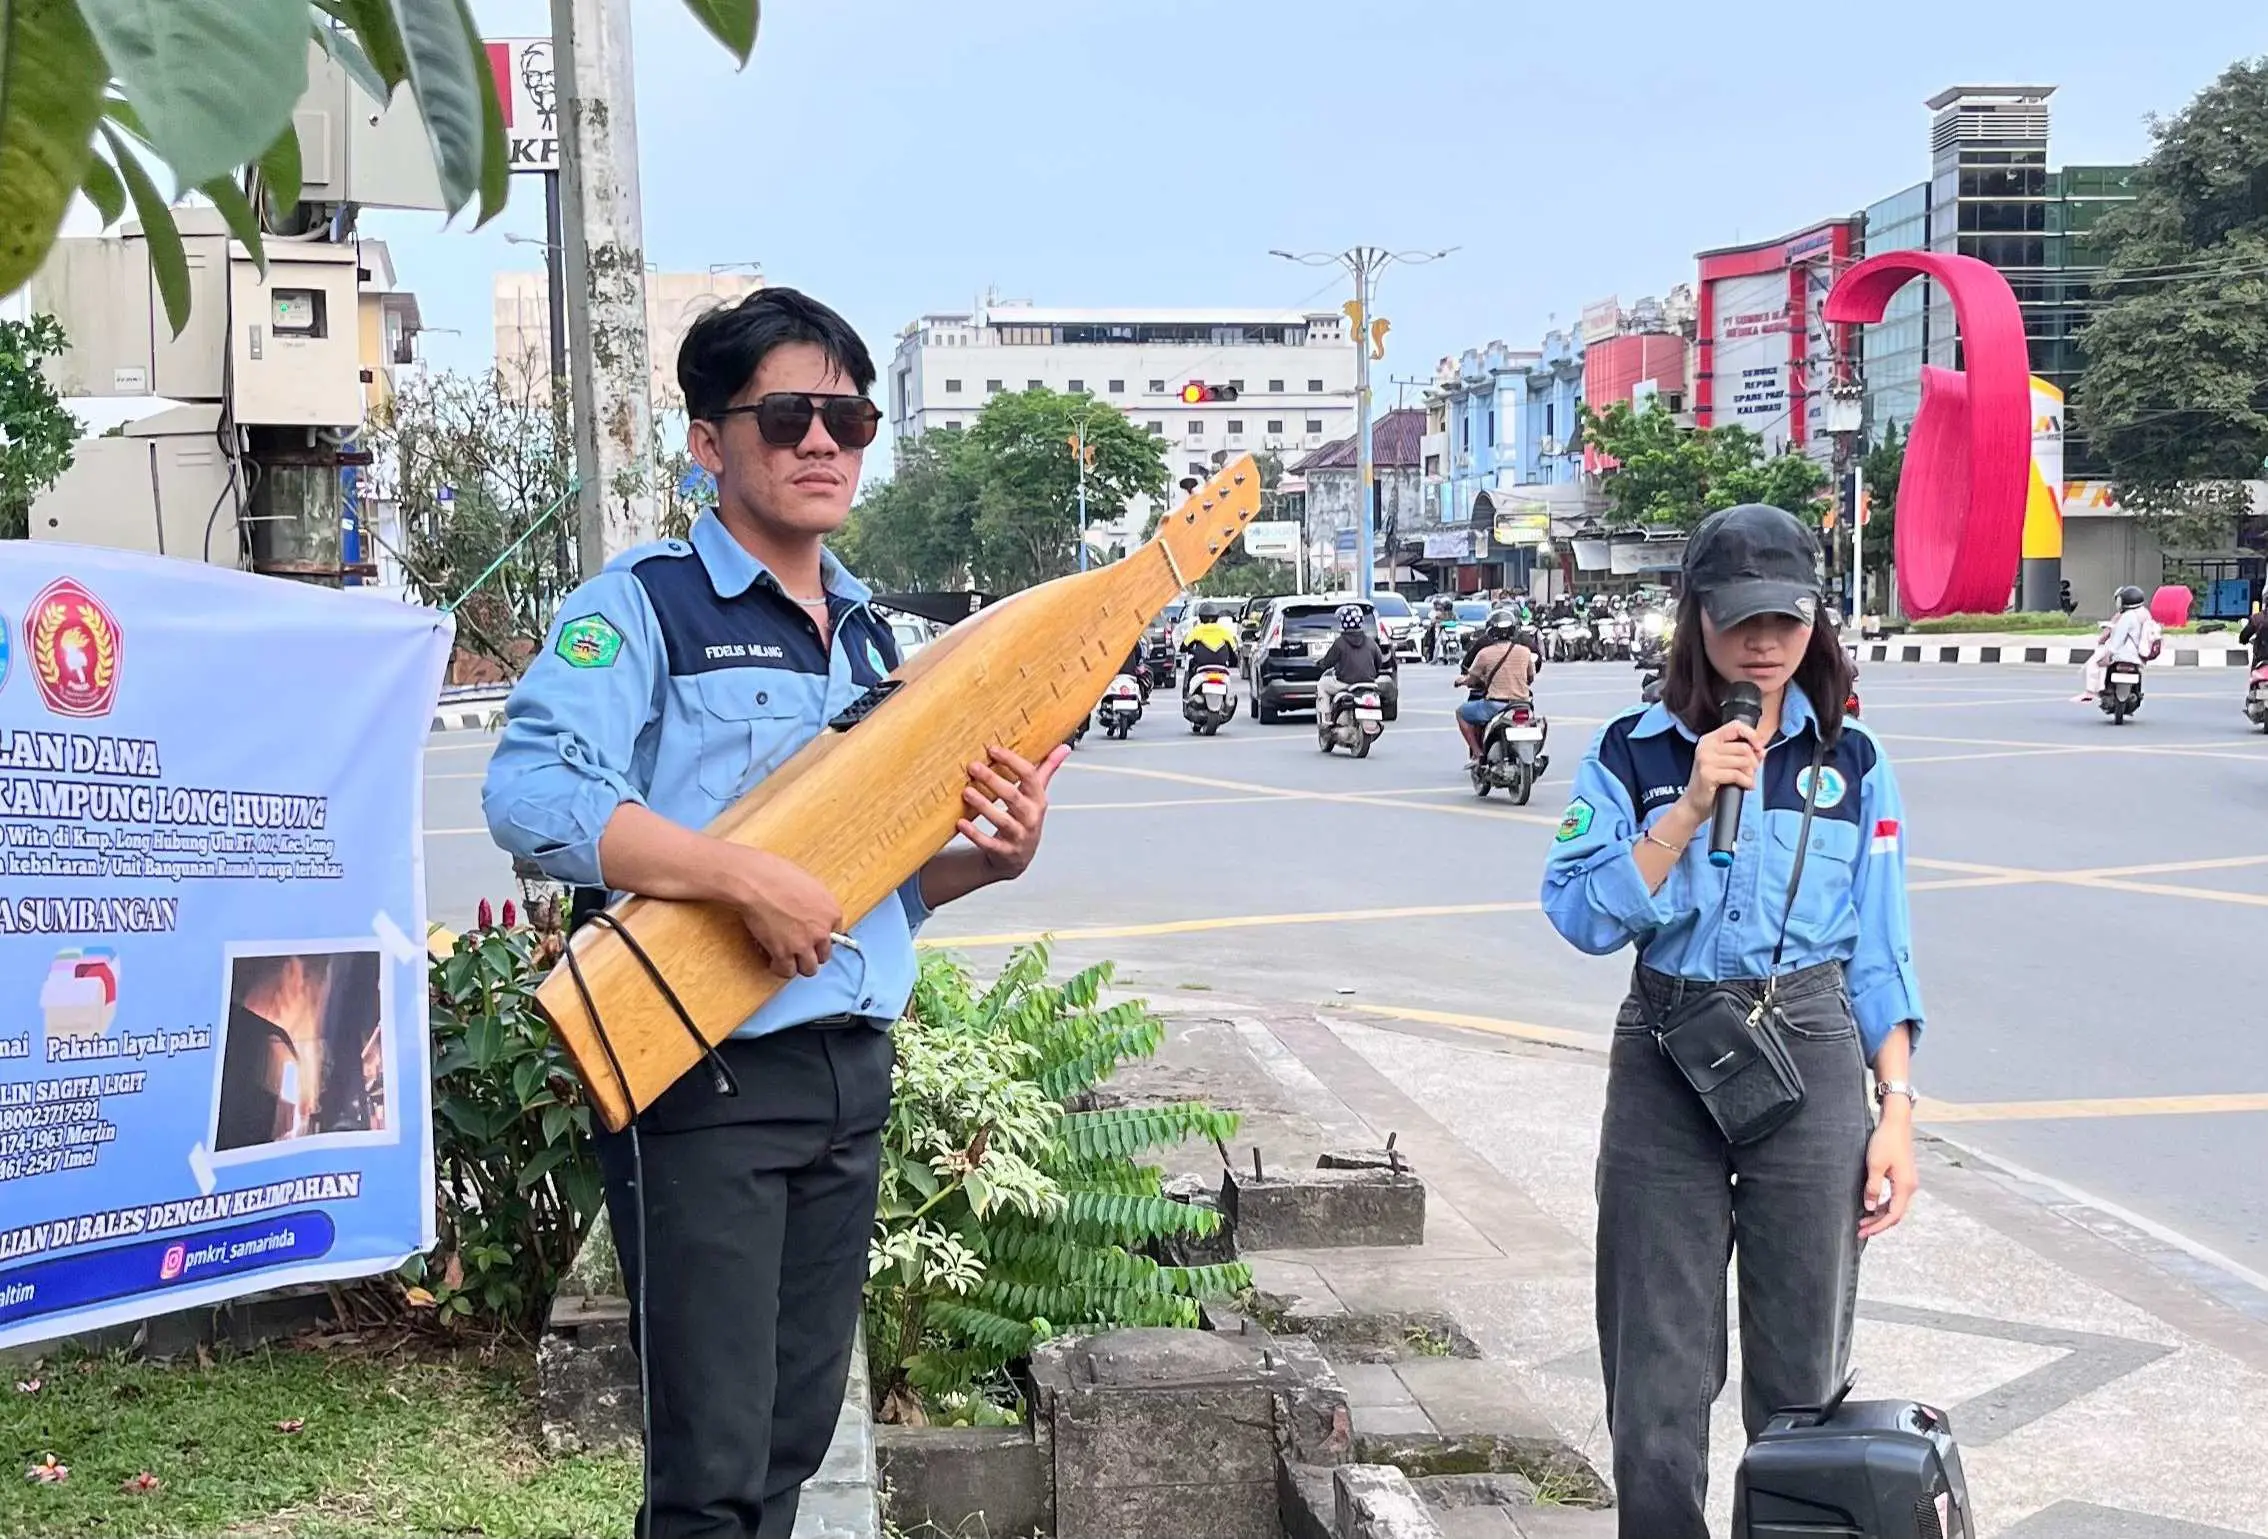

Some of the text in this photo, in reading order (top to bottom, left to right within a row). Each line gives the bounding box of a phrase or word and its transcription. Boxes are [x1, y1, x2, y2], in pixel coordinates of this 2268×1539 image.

[705, 645, 746, 659] FIDELIS
[71, 734, 161, 778] DANA
[155, 786, 228, 826] LONG
[232, 791, 327, 829] HUBUNG
[6, 824, 50, 848] Wita
[53, 825, 70, 848] di
[115, 828, 152, 855] Long
[152, 829, 209, 857] Hubung
[209, 831, 234, 853] Ulu
[304, 834, 335, 860] Long
[8, 852, 98, 876] kebakaran
[99, 855, 110, 877] 7
[111, 854, 143, 877] Unit
[144, 856, 215, 882] Bangunan
[258, 862, 293, 883] warga
[18, 896, 178, 933] SUMBANGAN
[47, 1034, 119, 1062] Pakaian
[122, 1028, 168, 1060] layak
[168, 1024, 212, 1057] pakai
[35, 1075, 101, 1103] SAGITA
[64, 1119, 117, 1147] Merlin
[61, 1143, 99, 1170] Imel
[50, 1218, 76, 1248] DI
[76, 1208, 147, 1242] BALES
[147, 1194, 232, 1233] DENGAN
[231, 1171, 362, 1218] KELIMPAHAN
[184, 1229, 296, 1273] pmkri_samarinda
